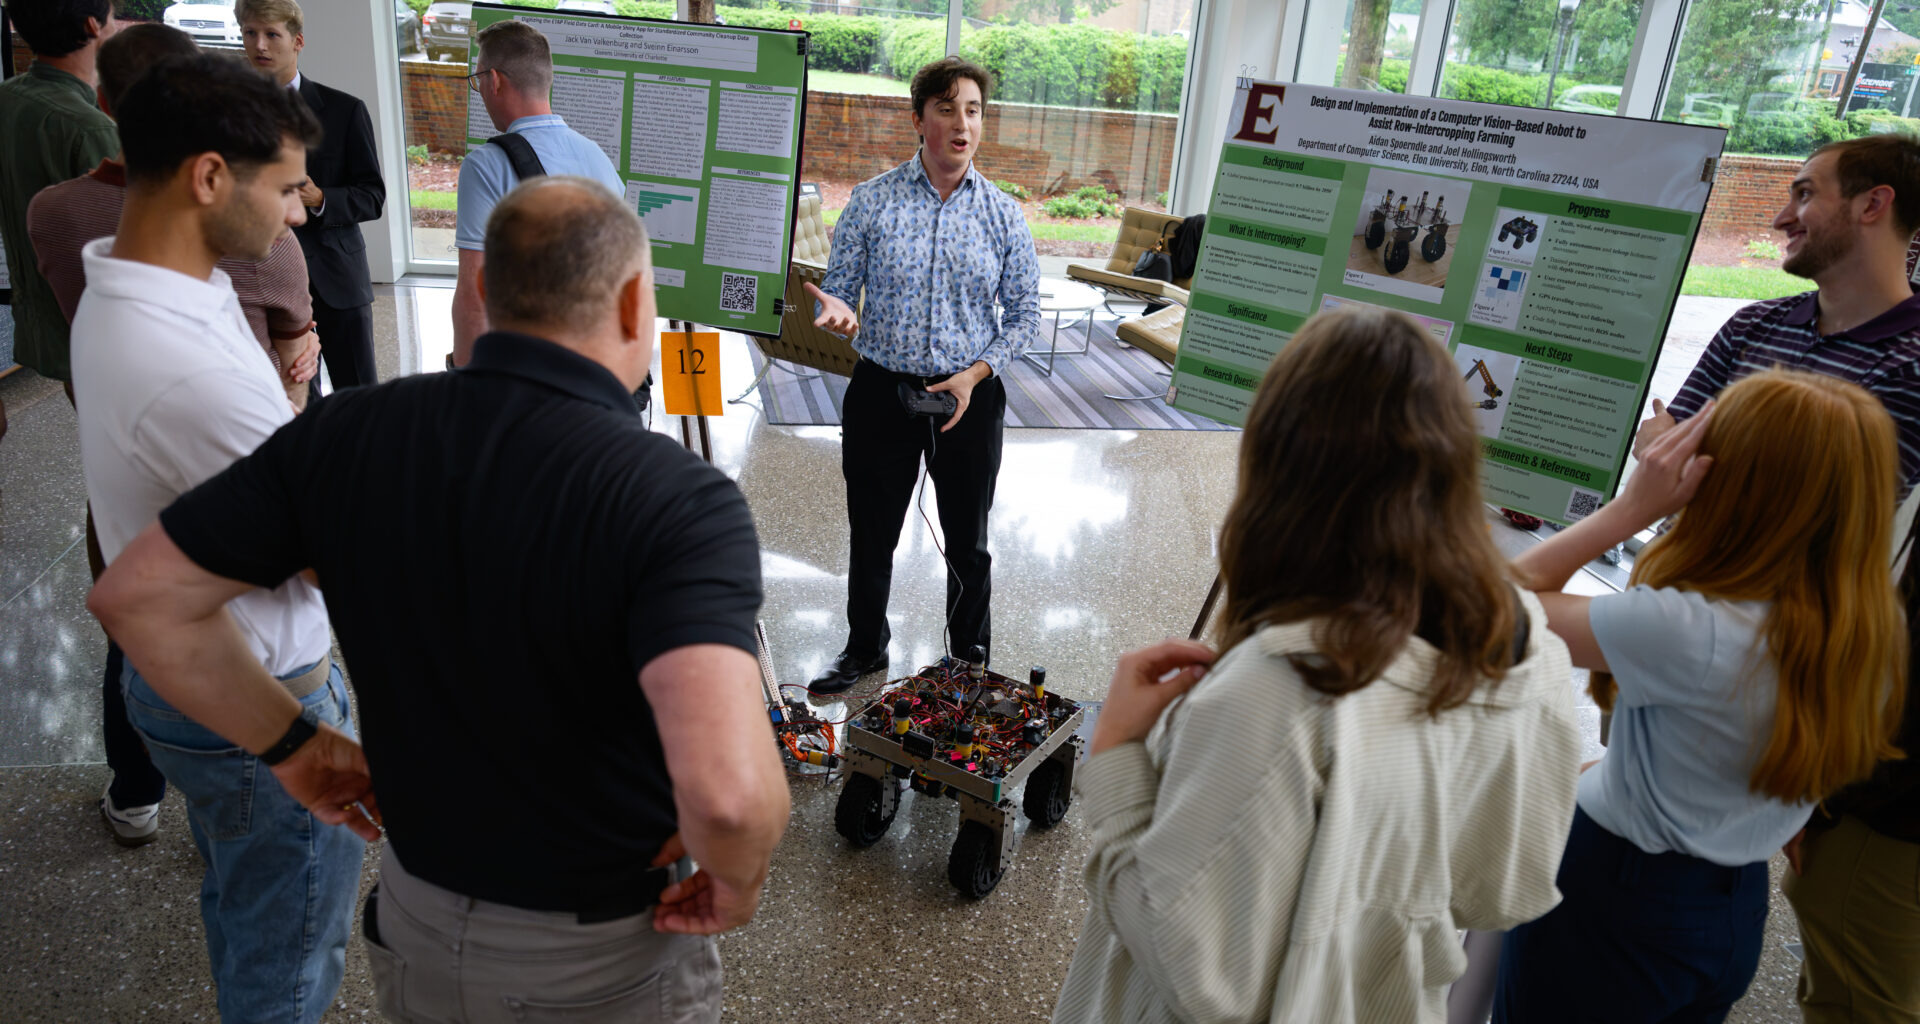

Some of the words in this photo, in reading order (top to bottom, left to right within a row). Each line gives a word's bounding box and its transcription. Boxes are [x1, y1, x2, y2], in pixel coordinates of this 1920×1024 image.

[655, 28, 686, 36] Standardized
[687, 30, 715, 38] Community
[565, 35, 578, 43] Jack
[580, 36, 591, 44] Van
[594, 38, 628, 48] Valkenburg
[630, 41, 642, 49] and
[644, 42, 665, 51] Sveinn
[667, 44, 698, 54] Einarsson
[1232, 83, 1285, 144] E
[1310, 95, 1336, 110] Design
[1337, 98, 1353, 109] and
[1354, 101, 1419, 118] Implementation
[1420, 108, 1430, 118] of
[1430, 111, 1436, 120] a
[1437, 110, 1482, 127] Computer
[1482, 115, 1544, 133] Vision-Based
[1545, 123, 1574, 136] Robot
[1575, 127, 1586, 138] to
[1369, 117, 1393, 128] Assist
[1393, 120, 1475, 141] Row-Intercropping
[1476, 130, 1515, 146] Farming
[1368, 135, 1389, 146] Aidan
[1390, 138, 1427, 152] Spoerndle
[1428, 143, 1443, 153] and
[1443, 145, 1460, 156] Joel
[1461, 148, 1516, 164] Hollingsworth
[1262, 156, 1304, 171] Background
[1298, 139, 1336, 151] Department
[1337, 143, 1345, 152] of
[1346, 145, 1380, 158] Computer
[1381, 150, 1410, 162] Science,
[1412, 154, 1428, 164] Elon
[1429, 156, 1469, 171] University,
[1471, 162, 1490, 173] Elon,
[1491, 165, 1515, 176] North
[1516, 169, 1550, 181] Carolina
[1551, 174, 1580, 186] 27244,
[1582, 178, 1599, 189] USA
[1567, 202, 1610, 219] Progress
[1228, 223, 1246, 235] What
[1247, 226, 1253, 236] is
[1254, 229, 1305, 248] Intercropping?
[1604, 228, 1639, 237] programmed
[1489, 247, 1505, 255] Figure
[1568, 261, 1594, 270] prototype
[1594, 266, 1620, 274] computer
[1227, 304, 1267, 322] Significance
[1557, 309, 1579, 318] tracking
[1590, 316, 1615, 325] following
[1529, 327, 1552, 336] Designed
[1552, 332, 1580, 341] specialized
[678, 348, 706, 374] 12
[1524, 342, 1545, 355] Next
[1546, 347, 1573, 363] Steps
[1526, 361, 1552, 370] Construct
[1203, 366, 1232, 381] Research
[1233, 374, 1258, 388] Questio
[1536, 382, 1557, 390] forward
[1511, 410, 1533, 419] software
[1514, 403, 1537, 412] Integrate
[1537, 408, 1552, 416] depth
[1553, 413, 1572, 421] camera
[1506, 427, 1528, 436] Conduct
[1540, 435, 1555, 443] world
[1555, 440, 1572, 448] testing
[1530, 455, 1538, 467] &
[1540, 459, 1591, 481] References
